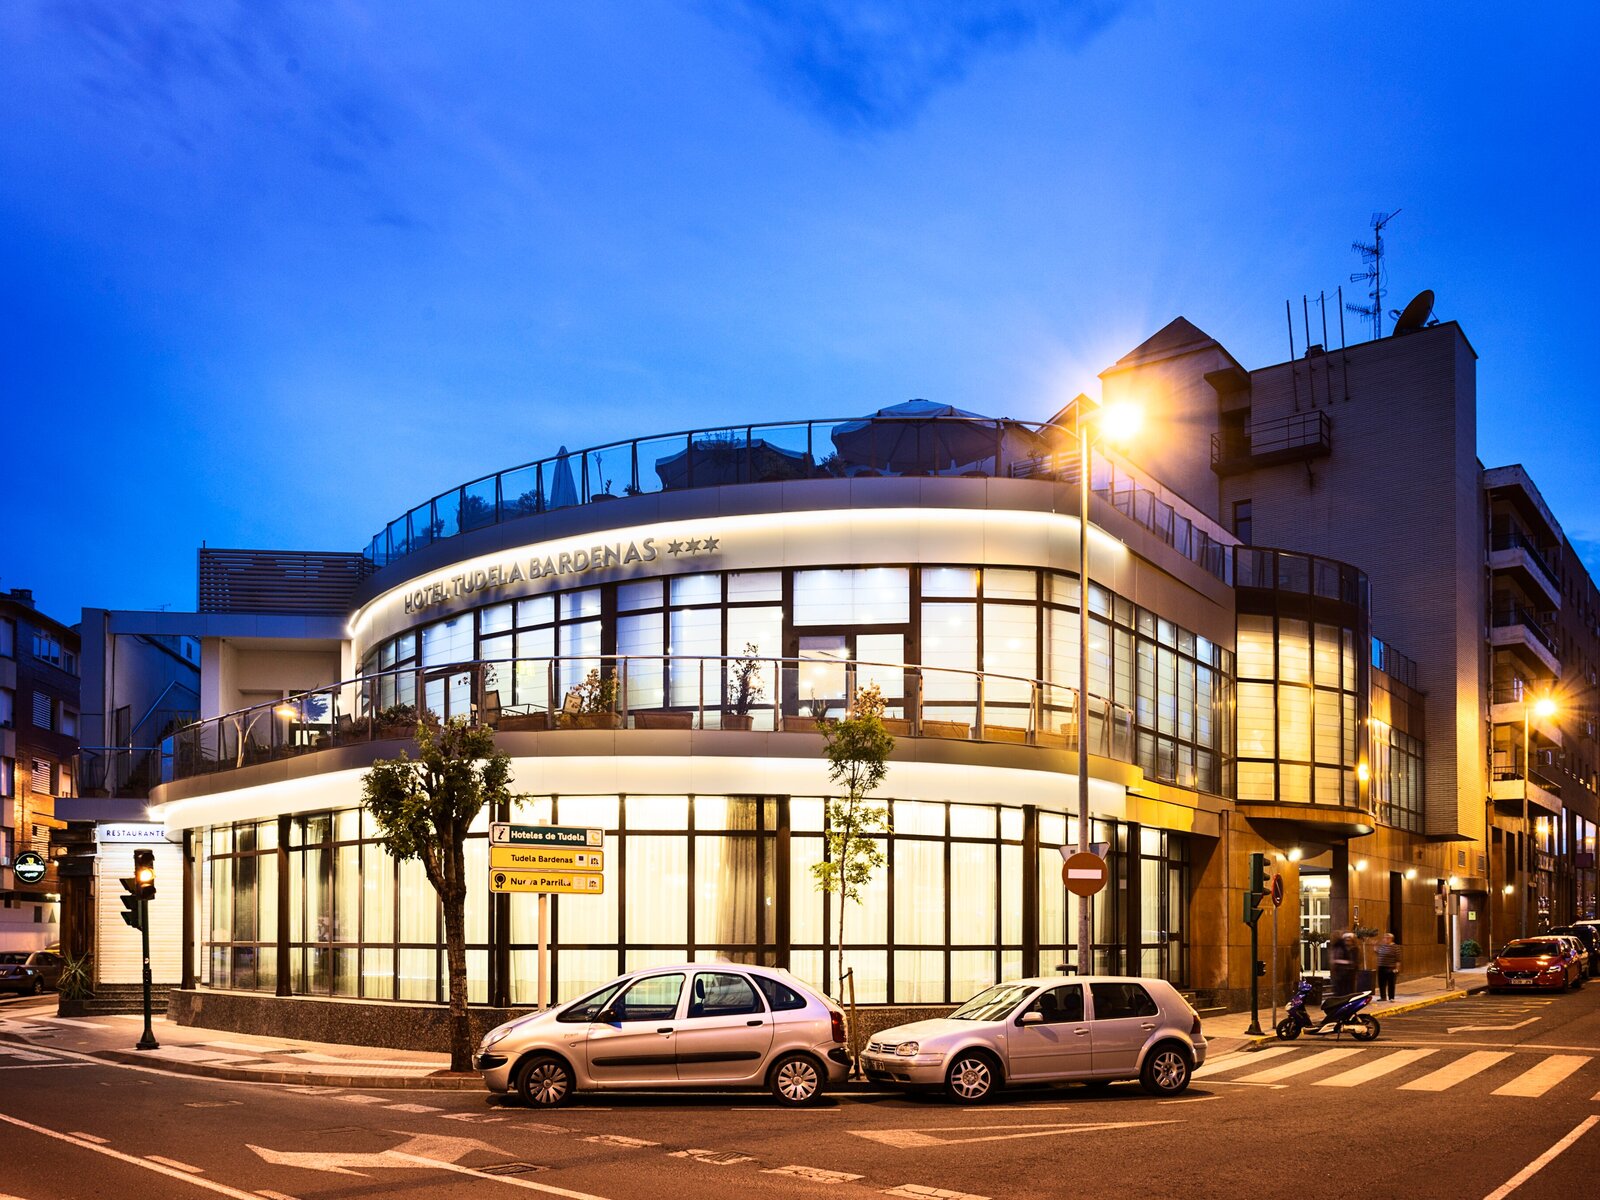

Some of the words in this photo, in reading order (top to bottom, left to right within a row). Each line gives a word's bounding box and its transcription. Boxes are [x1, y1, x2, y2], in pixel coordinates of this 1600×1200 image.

[404, 580, 449, 614] HOTEL
[451, 560, 524, 596] TUDELA
[529, 537, 657, 579] BARDENAS
[106, 829, 165, 837] RESTAURANTE
[511, 831, 543, 840] Hoteles
[557, 833, 585, 841] Tudela
[511, 854, 536, 863] Tudela
